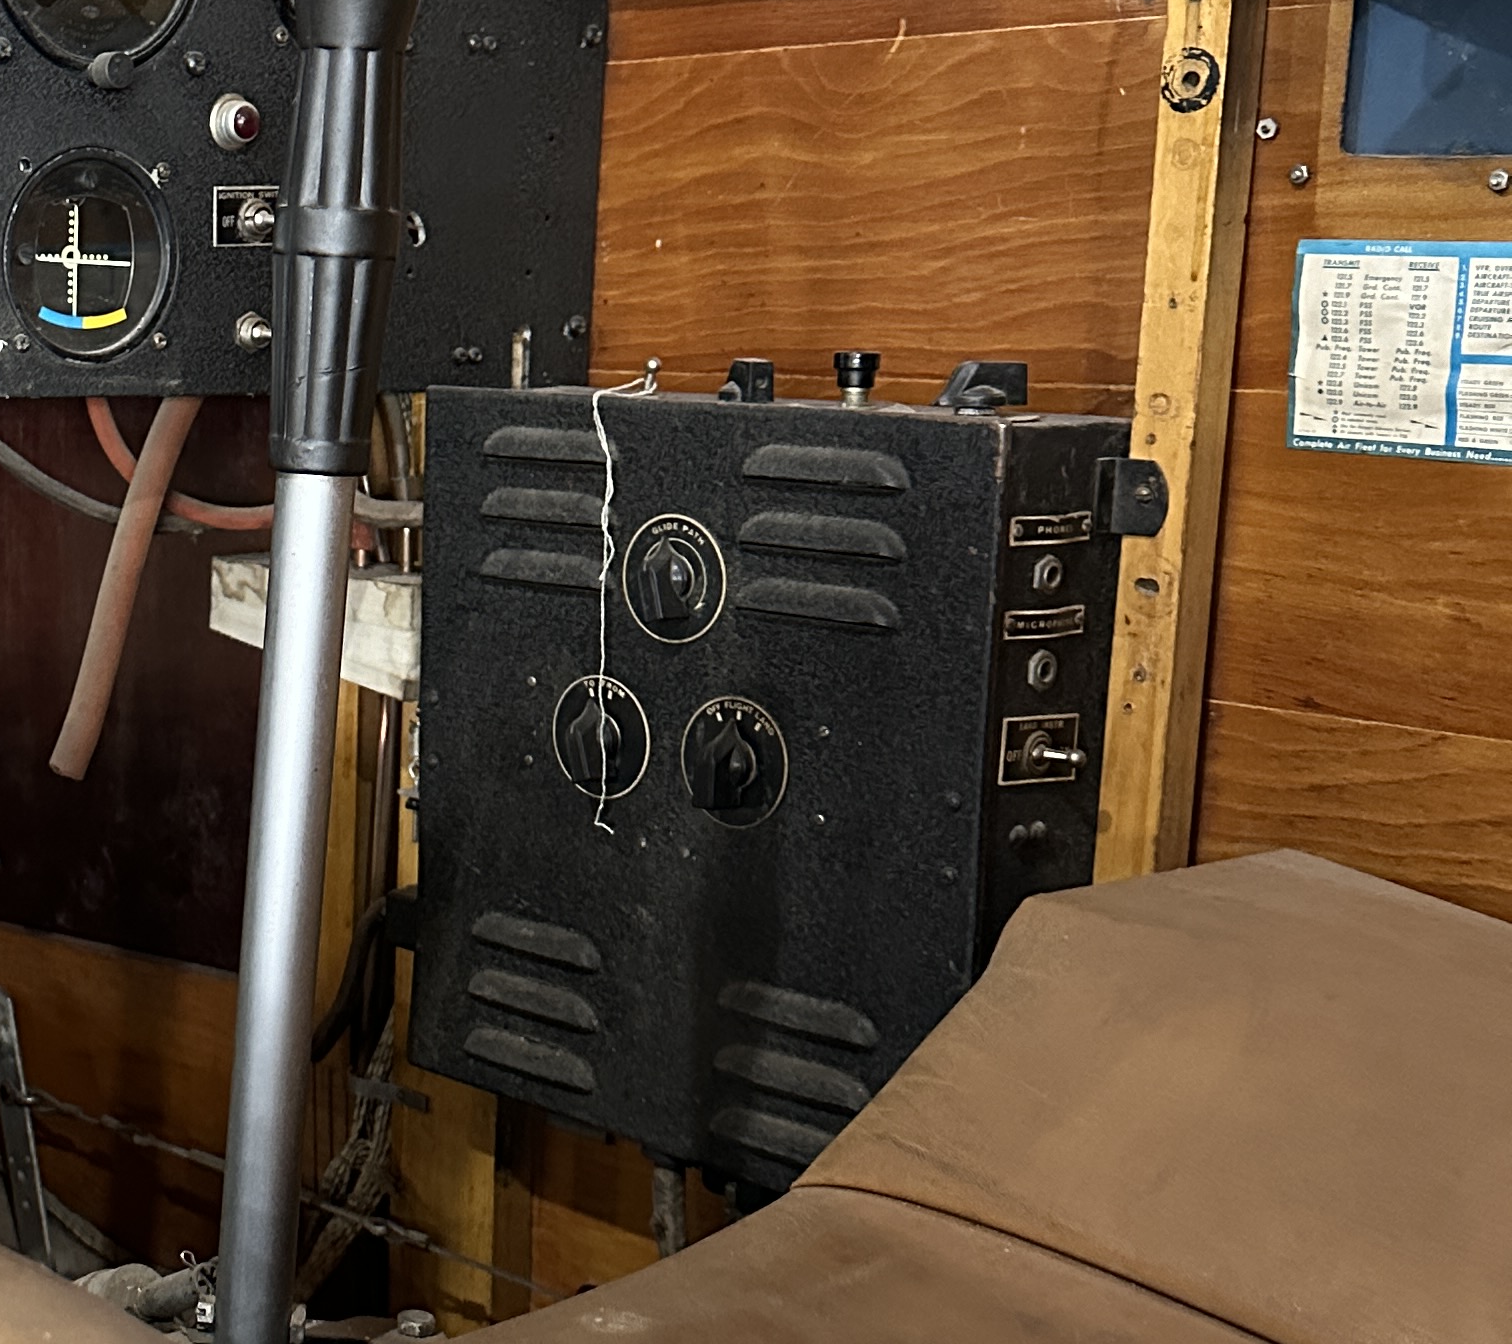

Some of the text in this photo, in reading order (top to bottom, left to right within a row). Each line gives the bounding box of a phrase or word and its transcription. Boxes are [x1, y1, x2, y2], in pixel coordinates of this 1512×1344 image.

[219, 191, 278, 200] IGNITION SWIT
[222, 215, 235, 228] OFF
[1293, 438, 1333, 449] Complete
[1337, 440, 1351, 449] Air
[1355, 442, 1376, 451] Fleet
[1380, 444, 1392, 453] for
[1396, 445, 1420, 456] Every
[1425, 447, 1461, 458] Business
[651, 522, 705, 546] GLIDE PATH
[583, 679, 626, 699] TO FROM
[706, 701, 775, 736] OFF FLIGHT LAND
[1006, 750, 1023, 762] OFF
